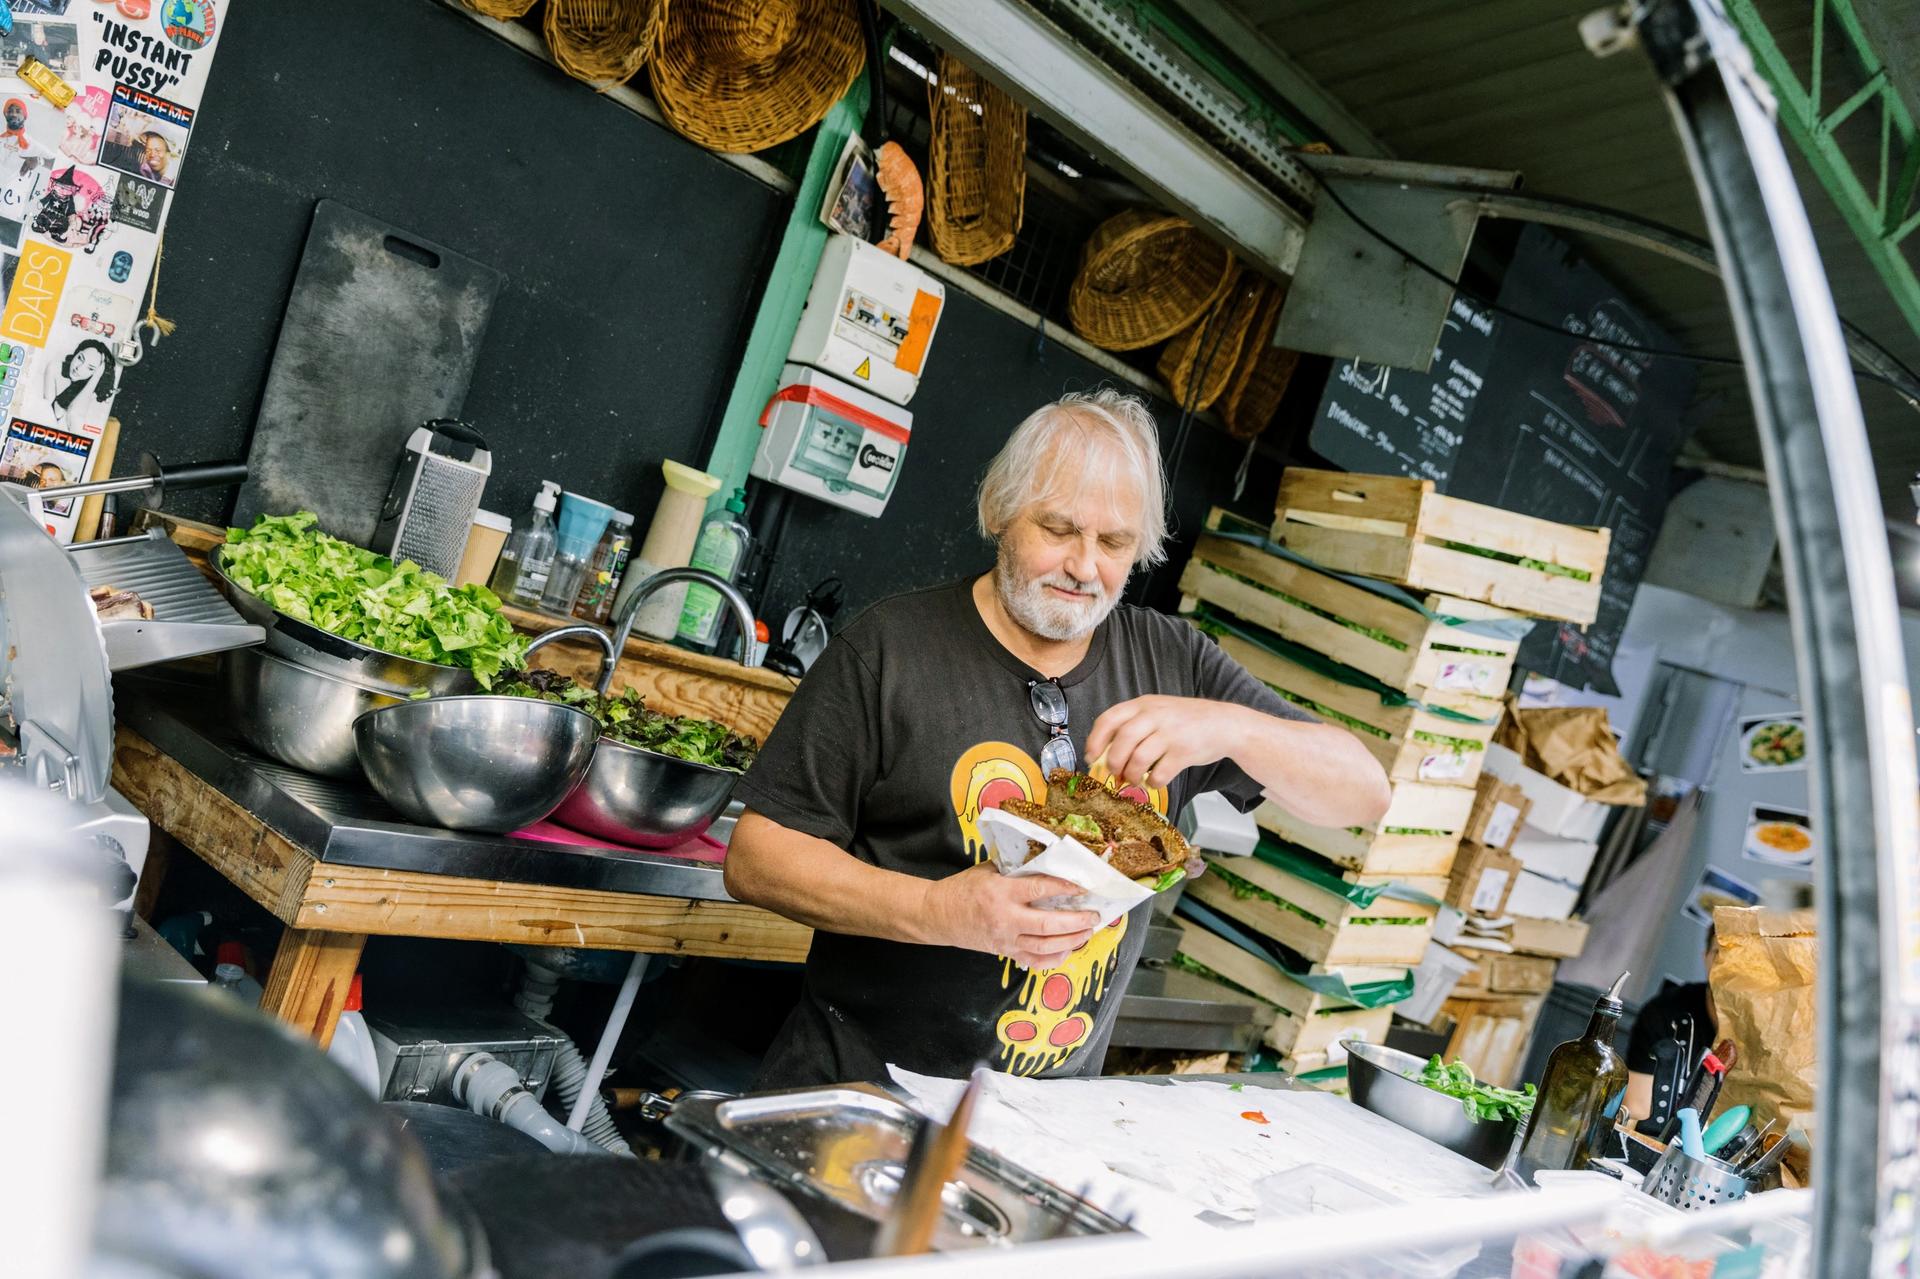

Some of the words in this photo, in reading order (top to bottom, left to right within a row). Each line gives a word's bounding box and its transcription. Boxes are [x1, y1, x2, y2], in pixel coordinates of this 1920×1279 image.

[114, 84, 195, 127] SUPREME
[9, 251, 63, 340] DAPS
[9, 420, 94, 455] SUPREME
